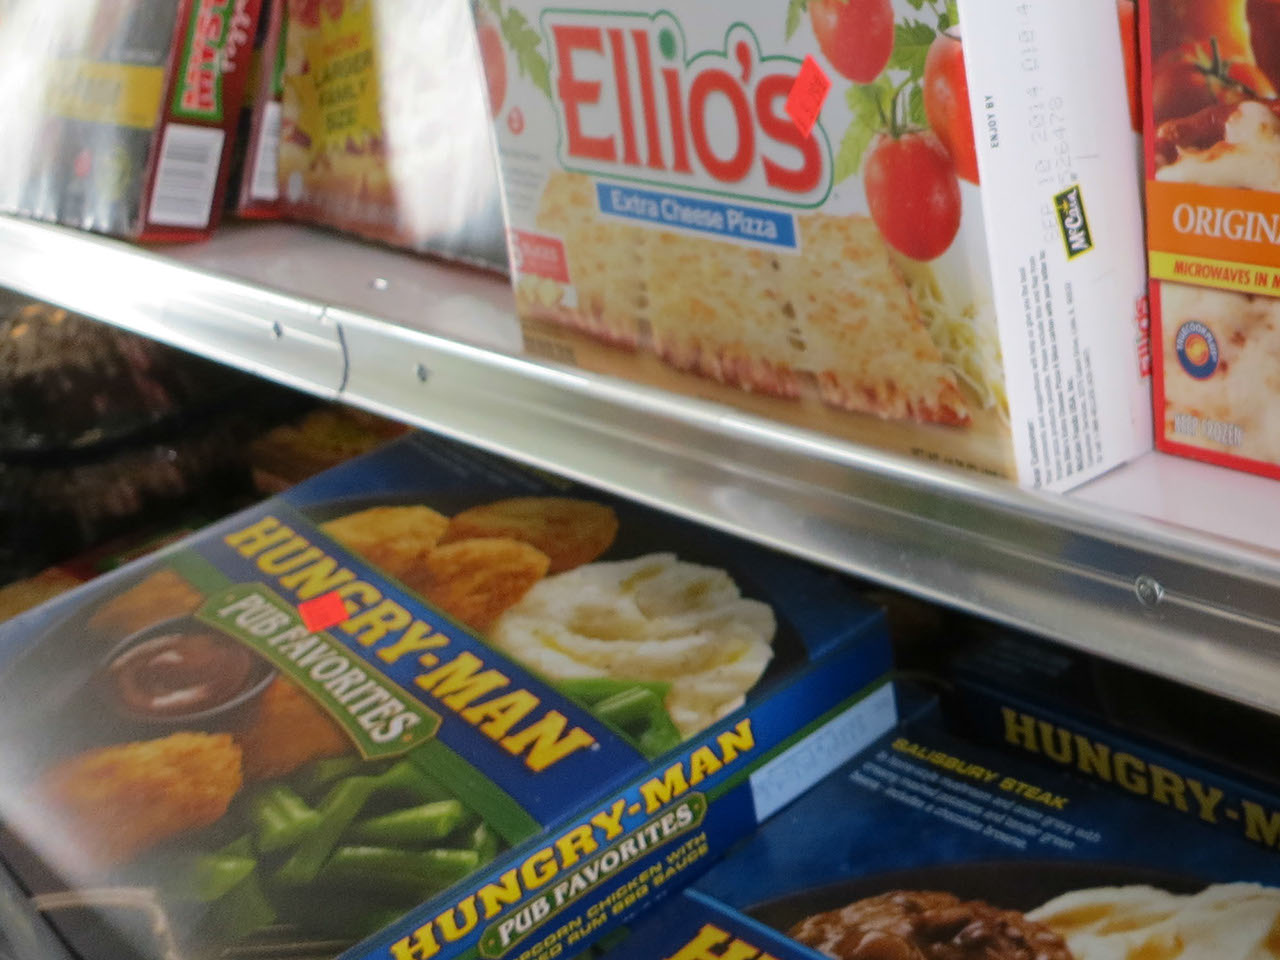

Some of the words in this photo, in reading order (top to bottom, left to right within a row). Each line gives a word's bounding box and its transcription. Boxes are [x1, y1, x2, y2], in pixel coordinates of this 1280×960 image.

[550, 25, 824, 194] Ellio's
[984, 95, 994, 110] BY
[986, 112, 1000, 150] ENJOY
[611, 189, 659, 220] Extra
[661, 197, 723, 233] Cheese
[727, 203, 778, 240] Pizza
[1064, 188, 1092, 254] McCain
[1174, 260, 1250, 286] MICROWAVES
[1255, 272, 1269, 287] IN
[217, 593, 290, 638] PUB
[268, 624, 421, 743] FAVORITES
[892, 738, 999, 783] SALISBURY
[999, 777, 1069, 810] STEAK
[390, 717, 759, 960] HUNGRY-MAN
[500, 896, 551, 947] PUB
[551, 803, 694, 906] FAVORITES
[587, 862, 663, 918] CHICKEN
[666, 832, 708, 864] WITH
[567, 913, 608, 945] RUM
[652, 843, 709, 888] SAUCE
